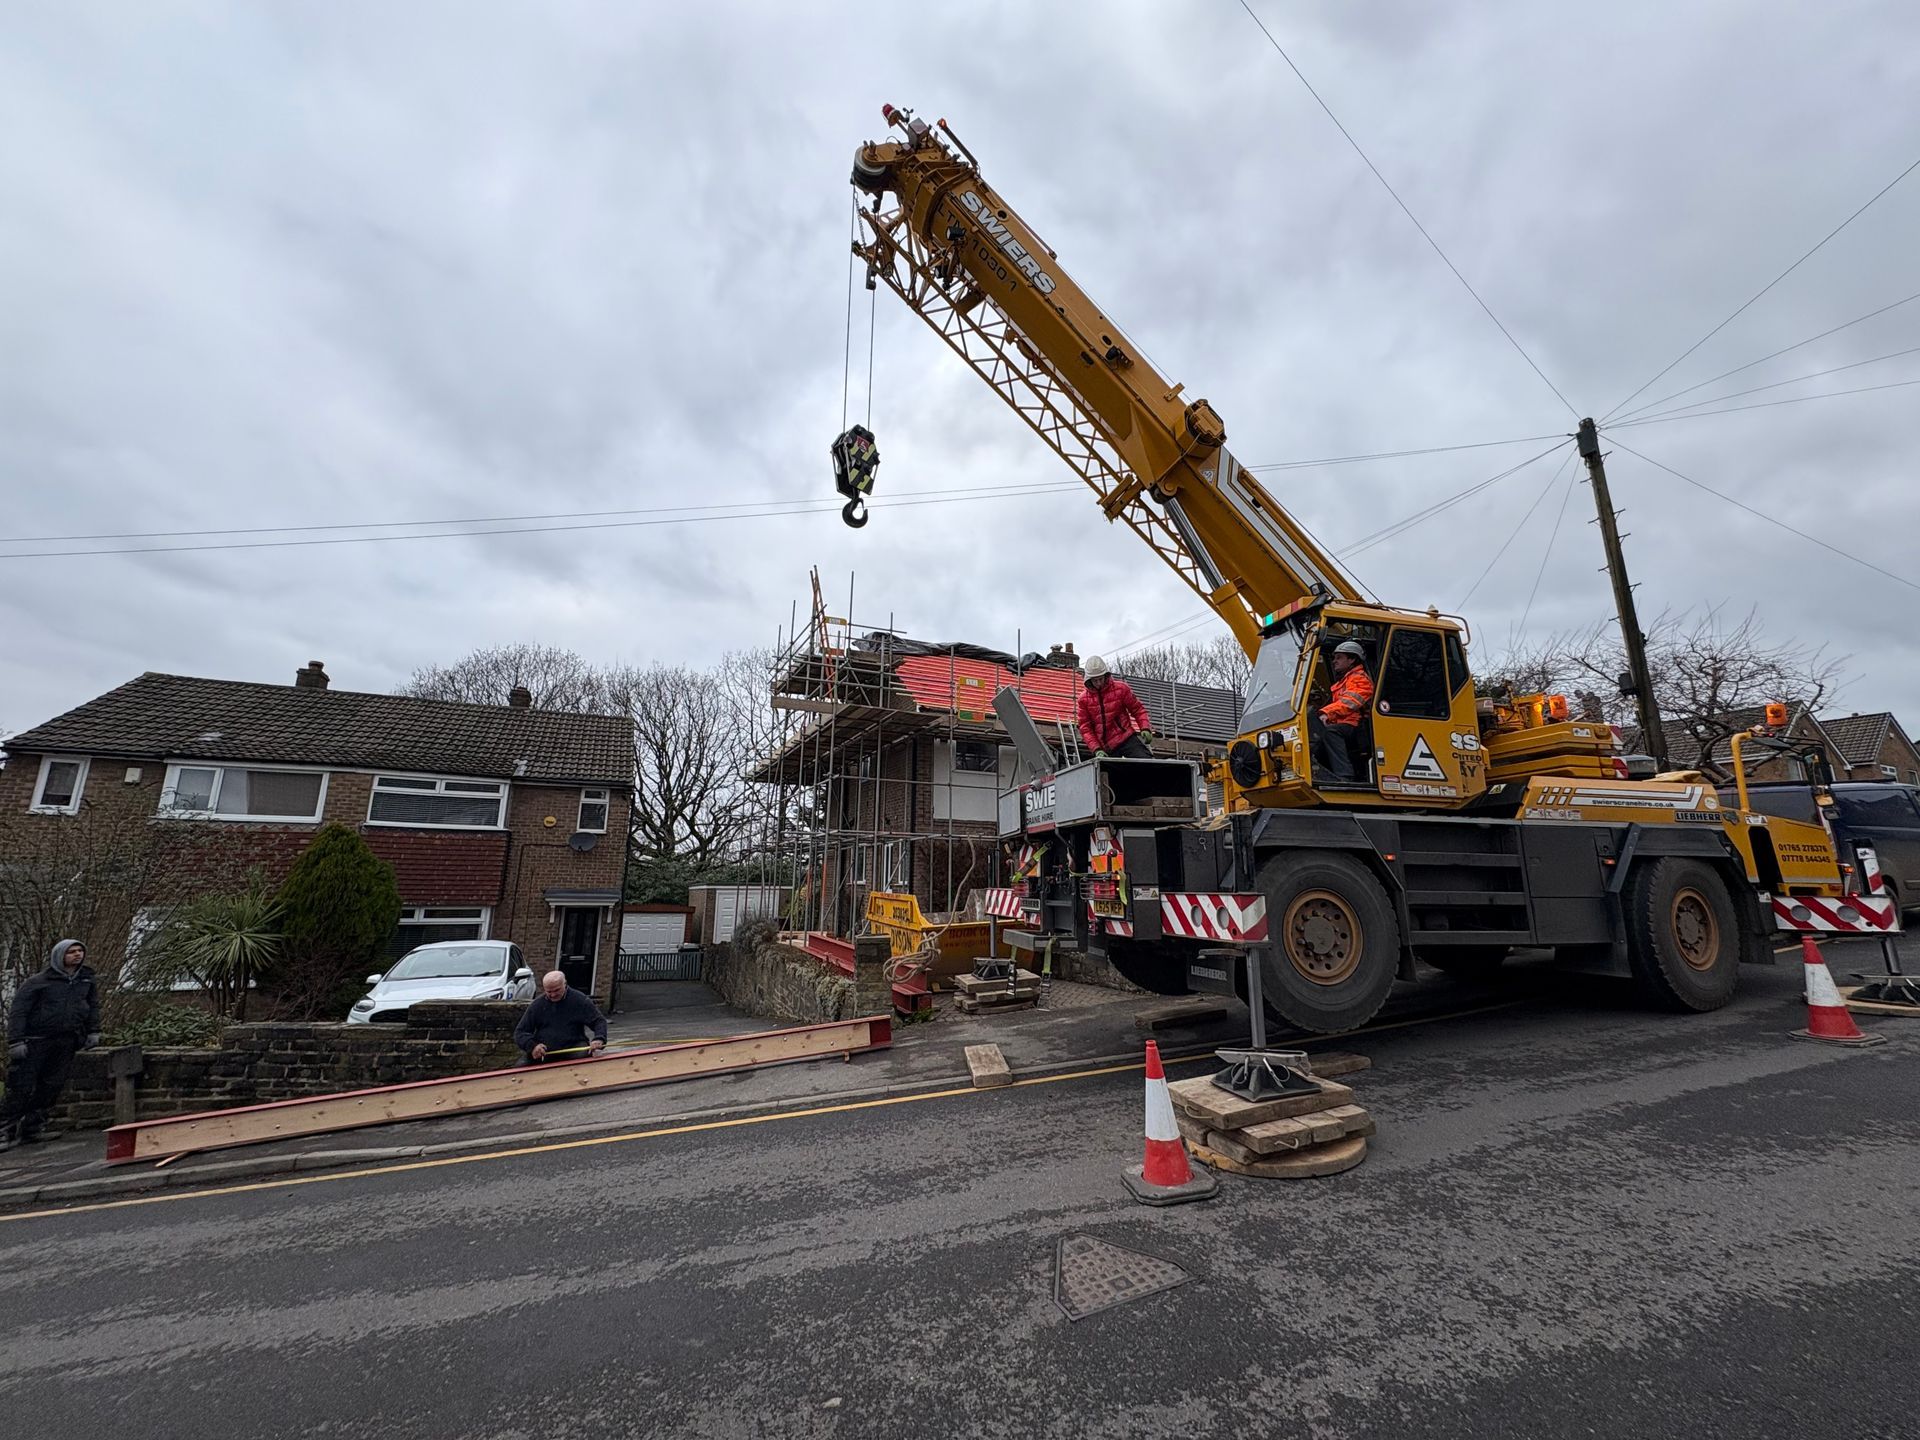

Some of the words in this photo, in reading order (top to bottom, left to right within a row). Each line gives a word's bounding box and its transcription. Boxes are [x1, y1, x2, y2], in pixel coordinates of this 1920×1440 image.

[960, 190, 1057, 295] SWIERS
[1592, 798, 1675, 808] swierscranehire.co.uk
[1041, 812, 1054, 822] HIRE
[1676, 812, 1721, 821] LIEBHERR
